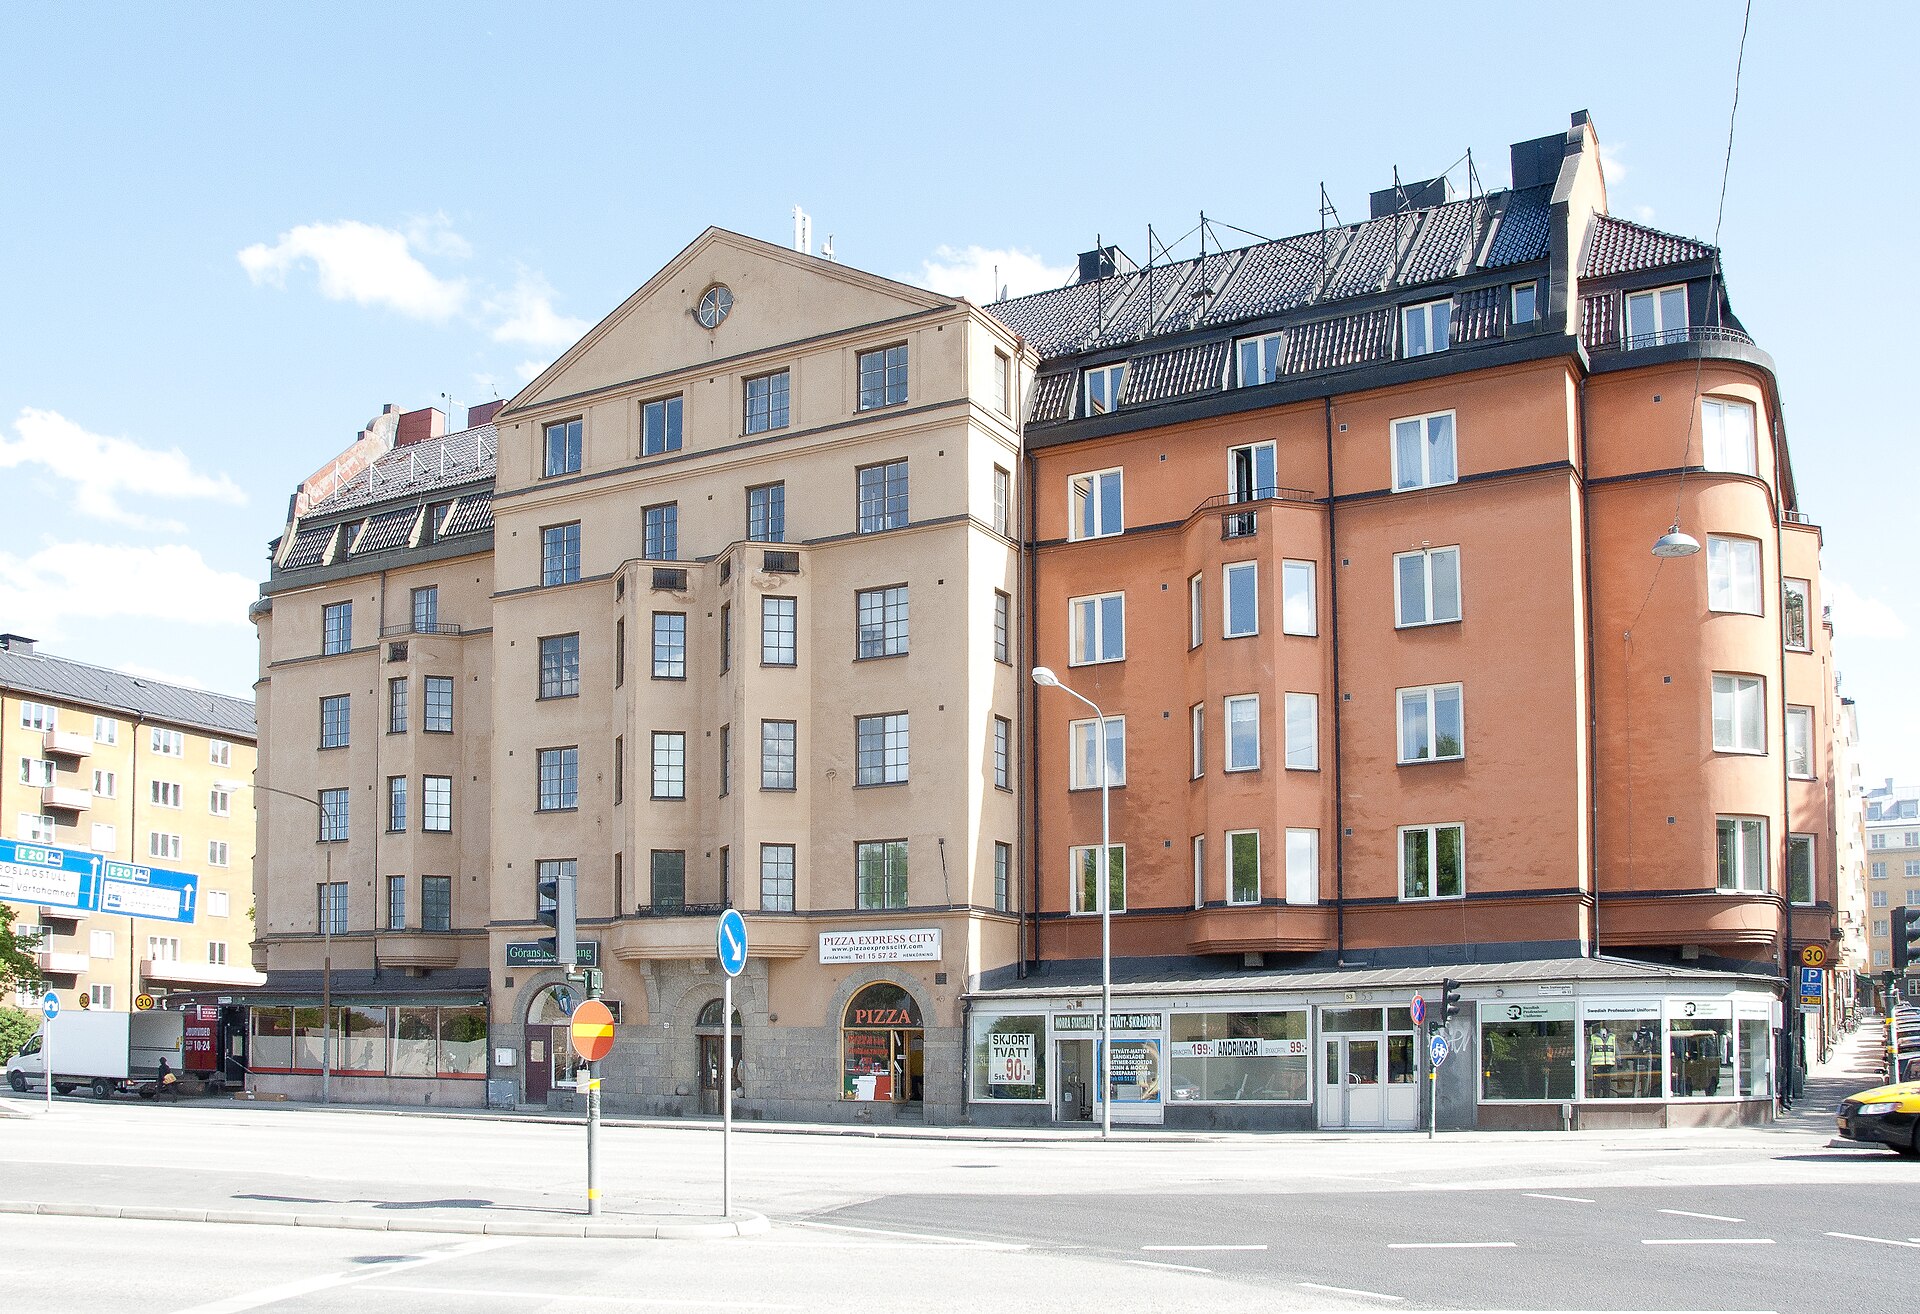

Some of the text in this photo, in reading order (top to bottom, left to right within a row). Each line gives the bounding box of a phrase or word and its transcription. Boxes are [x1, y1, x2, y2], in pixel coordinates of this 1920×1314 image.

[824, 933, 936, 946] PIZZA EXPRESS CITY
[509, 946, 541, 958] Görans
[1804, 949, 1823, 962] 30
[1808, 969, 1818, 982] P
[138, 998, 152, 1007] 30
[855, 1009, 912, 1024] PIZZA
[992, 1034, 1031, 1045] SKJORT
[993, 1044, 1030, 1058] TVÄTT
